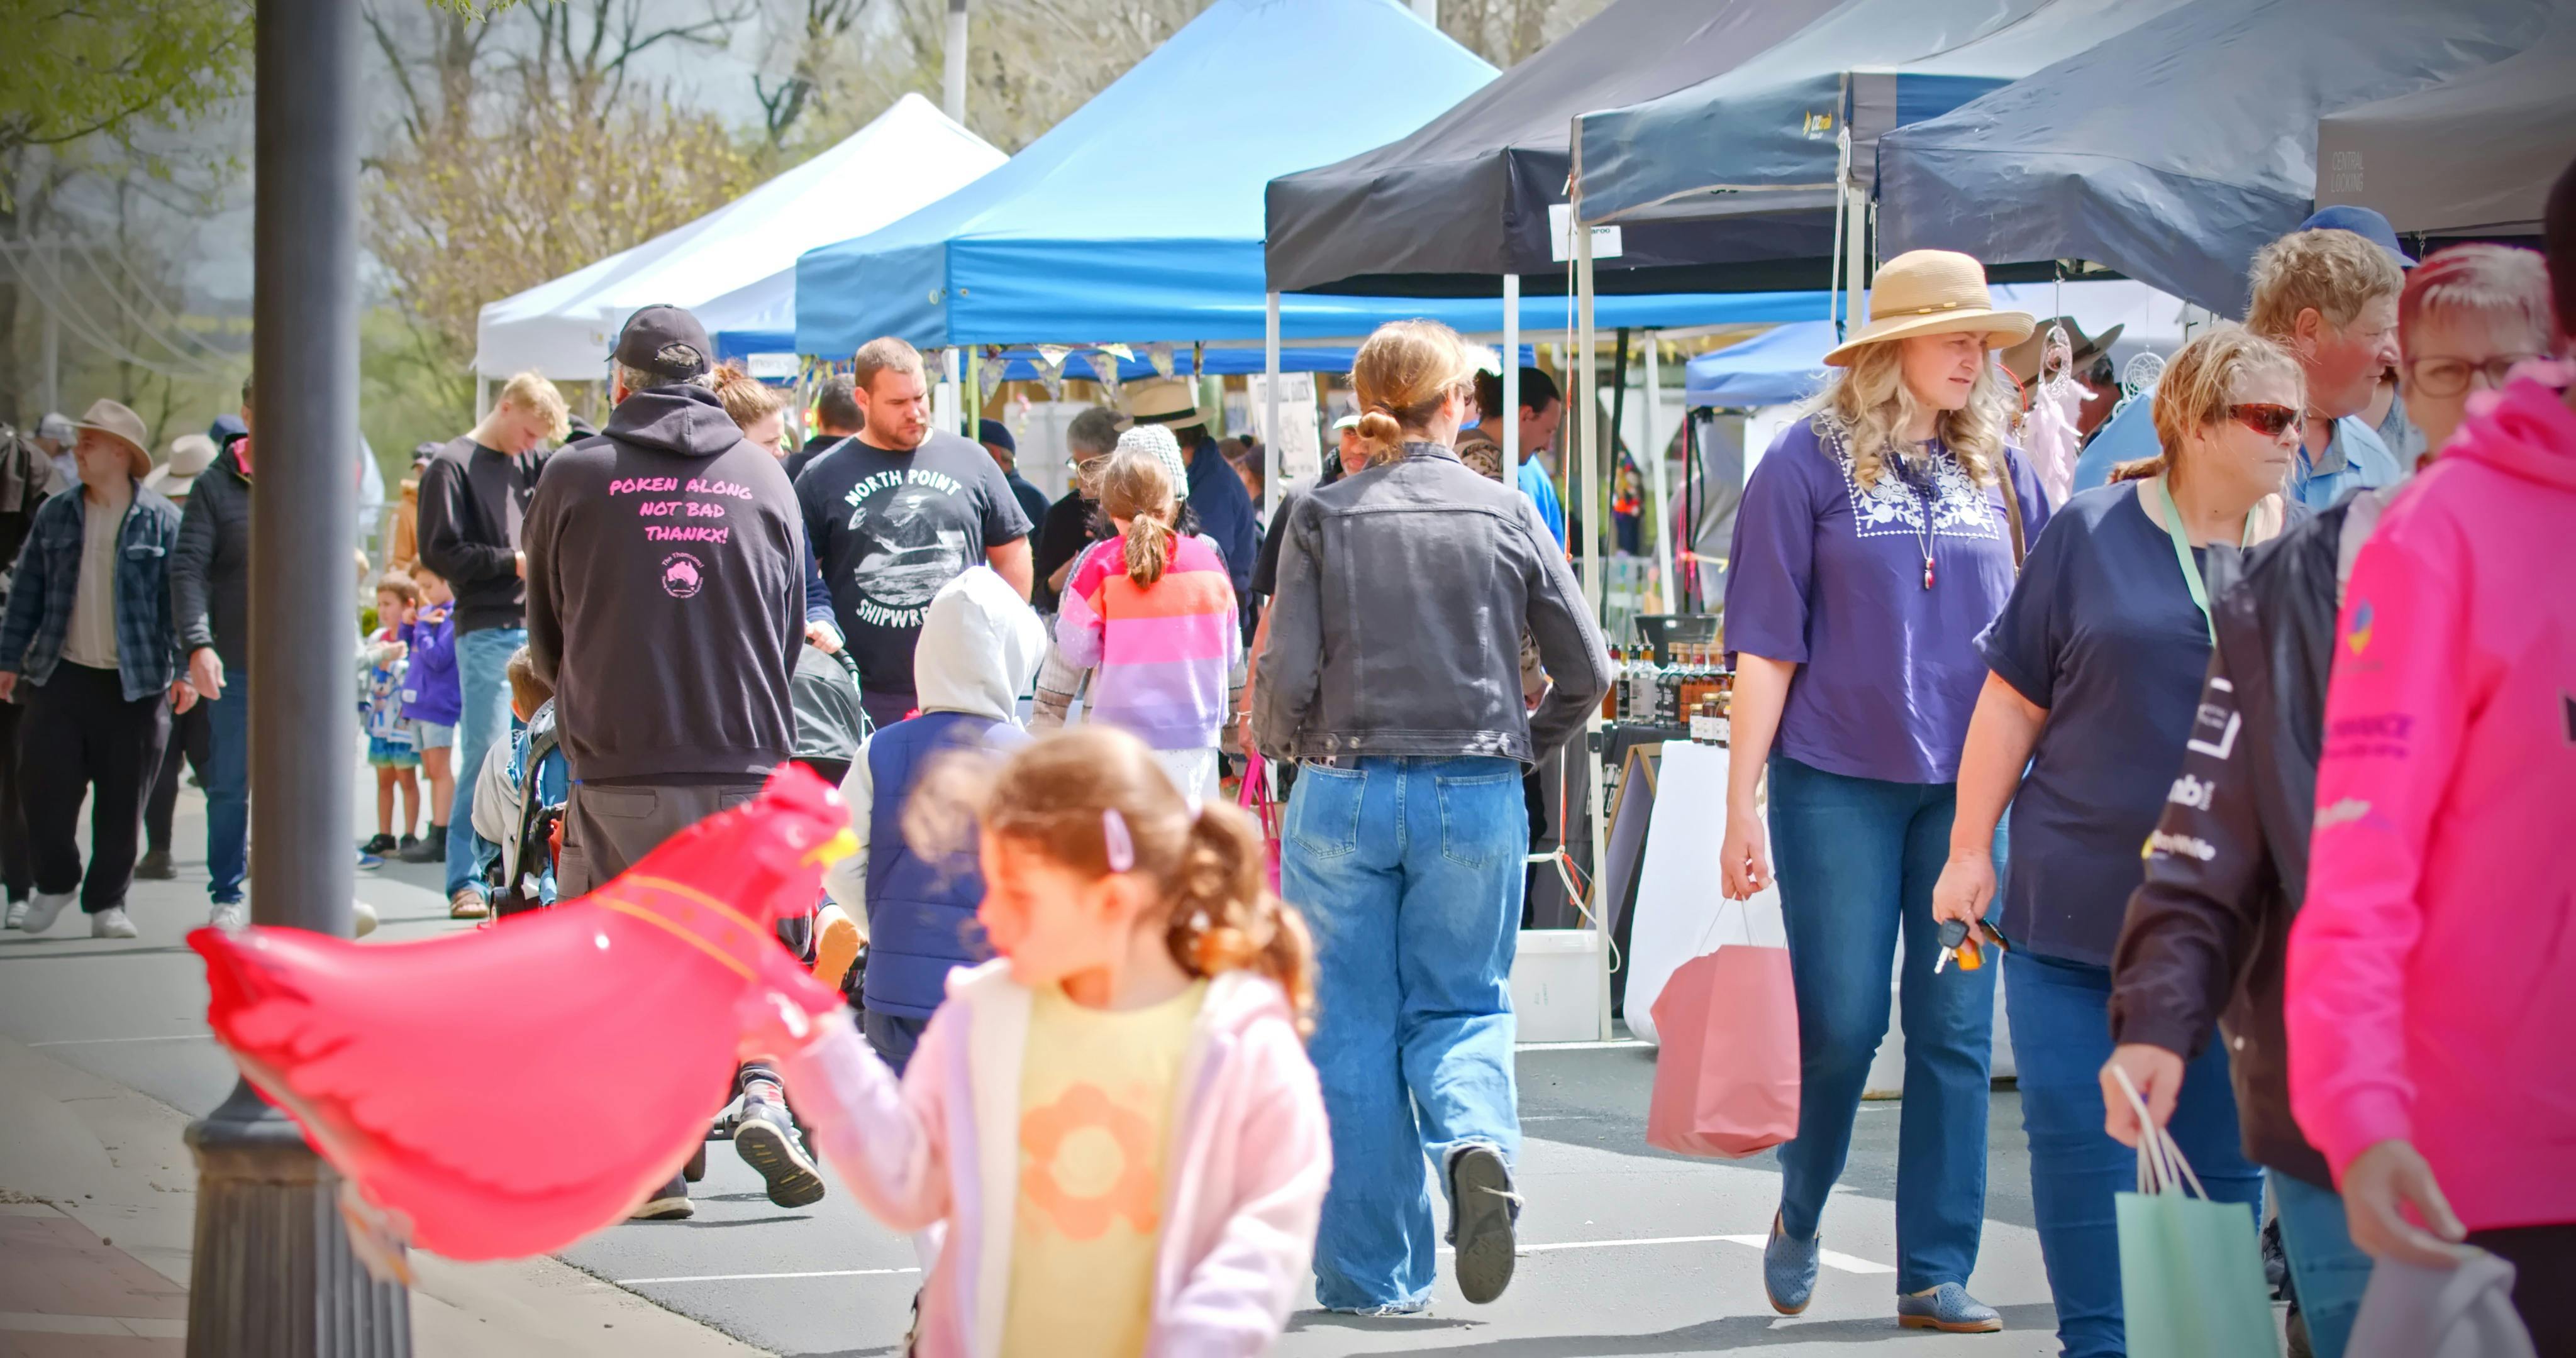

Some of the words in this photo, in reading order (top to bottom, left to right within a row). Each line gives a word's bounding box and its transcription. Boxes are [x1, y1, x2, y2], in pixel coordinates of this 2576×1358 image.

[2331, 152, 2363, 170] CENTRAL
[2331, 173, 2363, 192] LOCKING
[609, 477, 679, 495] POKEN
[685, 478, 753, 499] ALONG
[845, 470, 903, 507] NORTH
[908, 469, 962, 496] POINT
[640, 501, 682, 516] NOT
[686, 502, 725, 517] BAD
[645, 526, 729, 544] THANKX!
[662, 556, 672, 566] The
